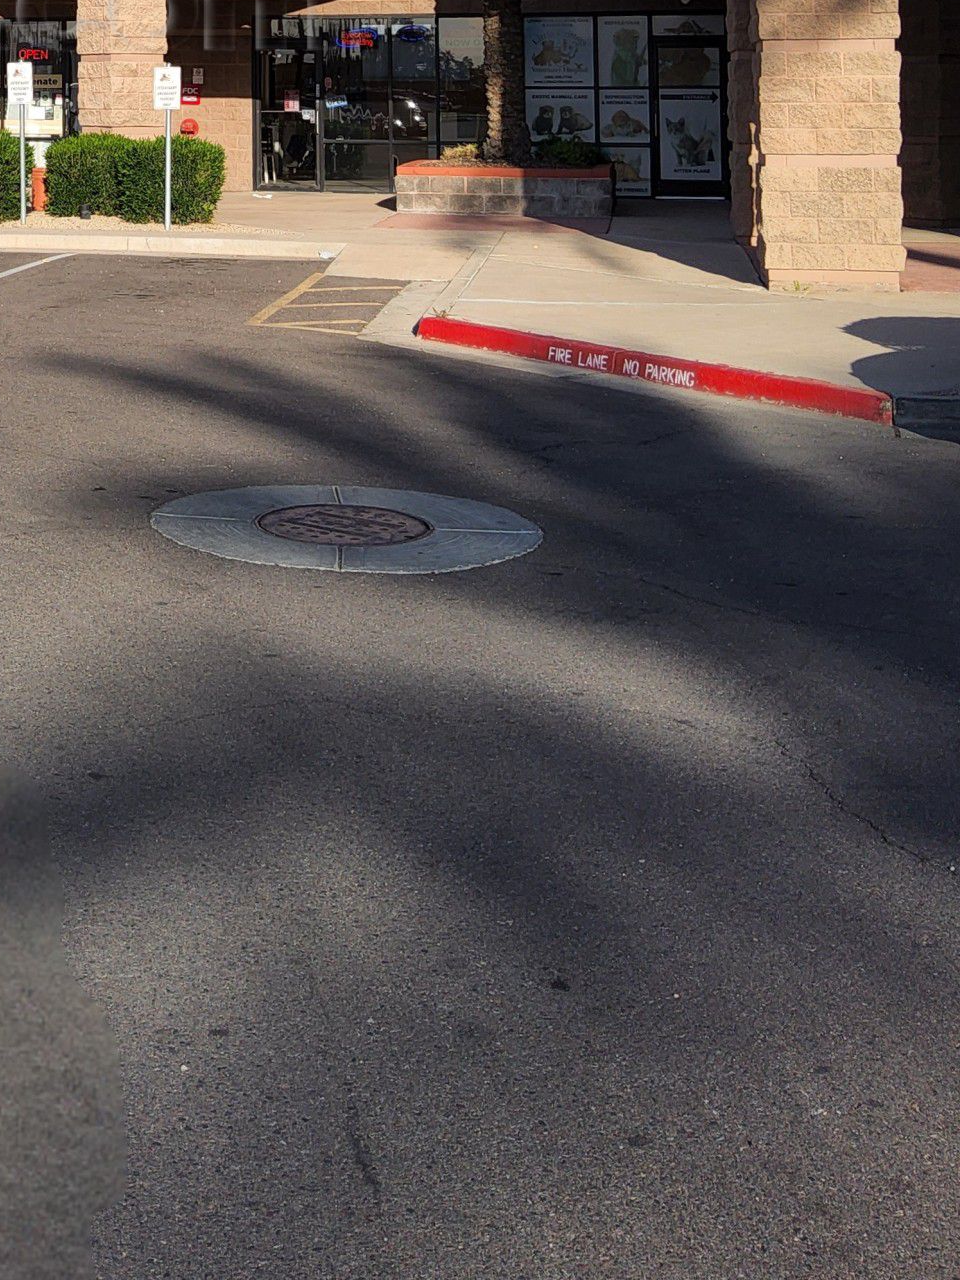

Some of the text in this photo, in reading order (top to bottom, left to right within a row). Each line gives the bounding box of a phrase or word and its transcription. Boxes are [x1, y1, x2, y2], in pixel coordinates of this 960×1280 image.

[19, 49, 48, 60] OPEN
[548, 346, 608, 370] FIRE LANE
[623, 359, 695, 387] NO PARKING
